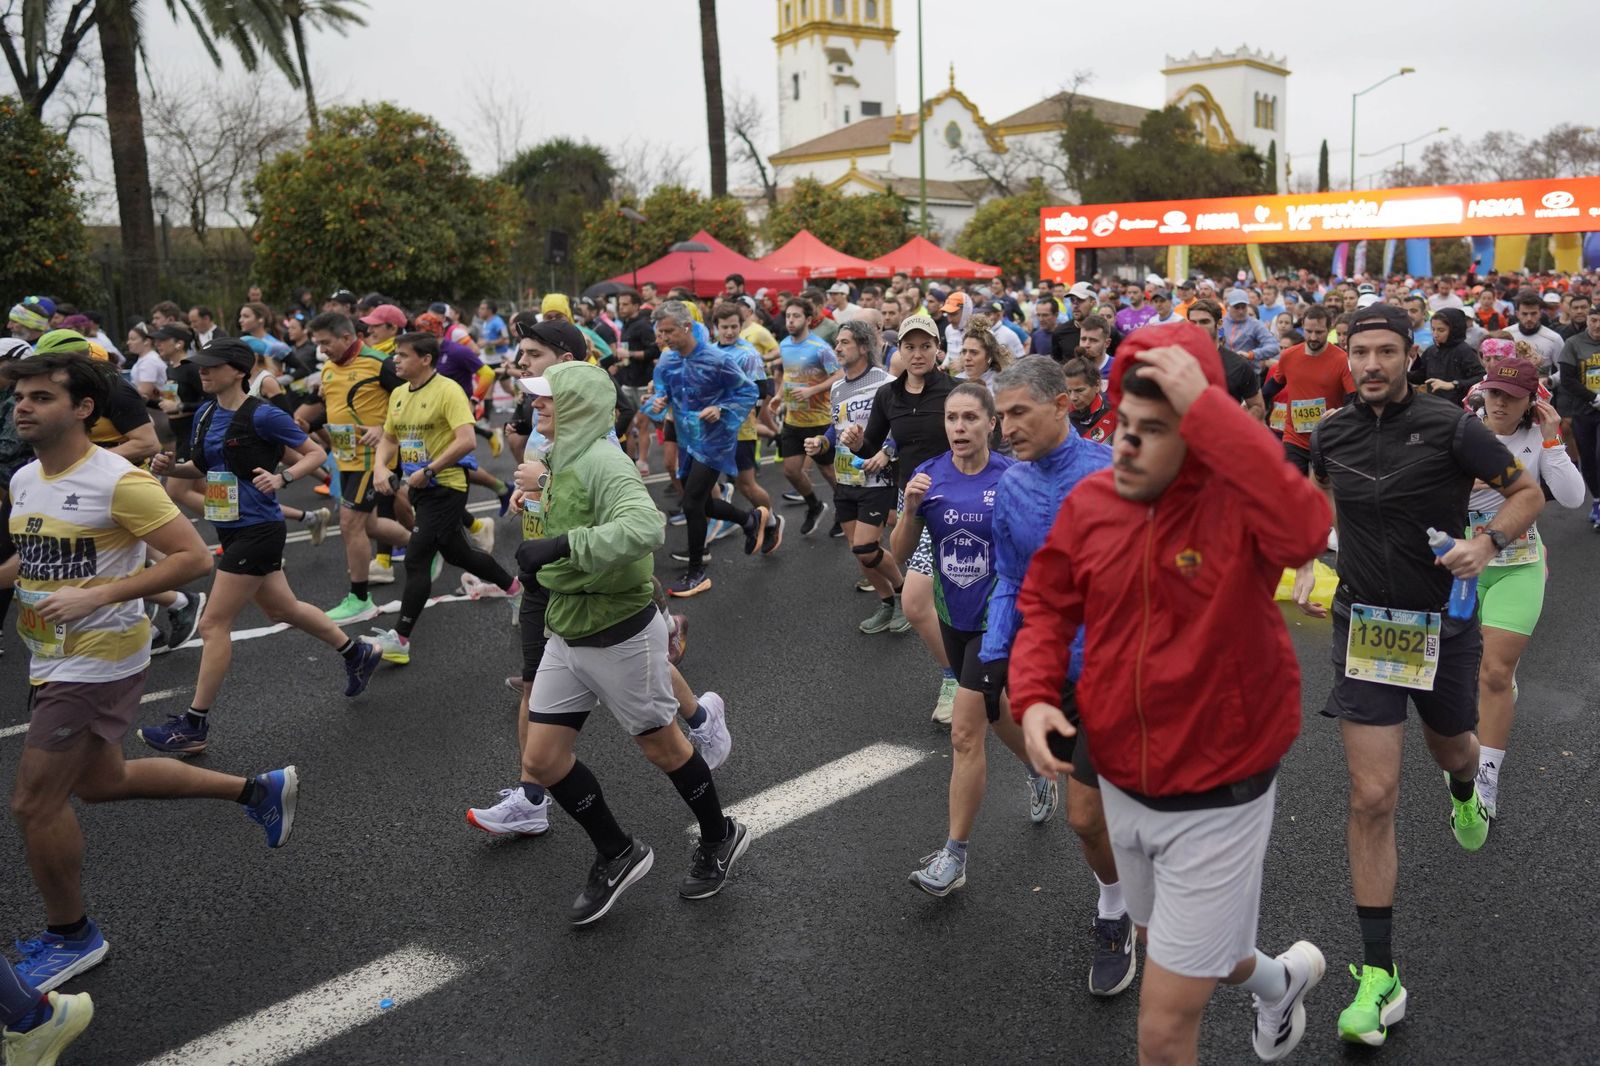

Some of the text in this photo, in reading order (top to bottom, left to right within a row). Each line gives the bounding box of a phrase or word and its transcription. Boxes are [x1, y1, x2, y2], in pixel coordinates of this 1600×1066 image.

[1294, 407, 1321, 419] 14363
[961, 513, 983, 522] CEU
[25, 517, 43, 533] 59
[953, 537, 972, 546] 15K
[947, 563, 980, 573] Sevilla
[1359, 623, 1425, 653] 13052
